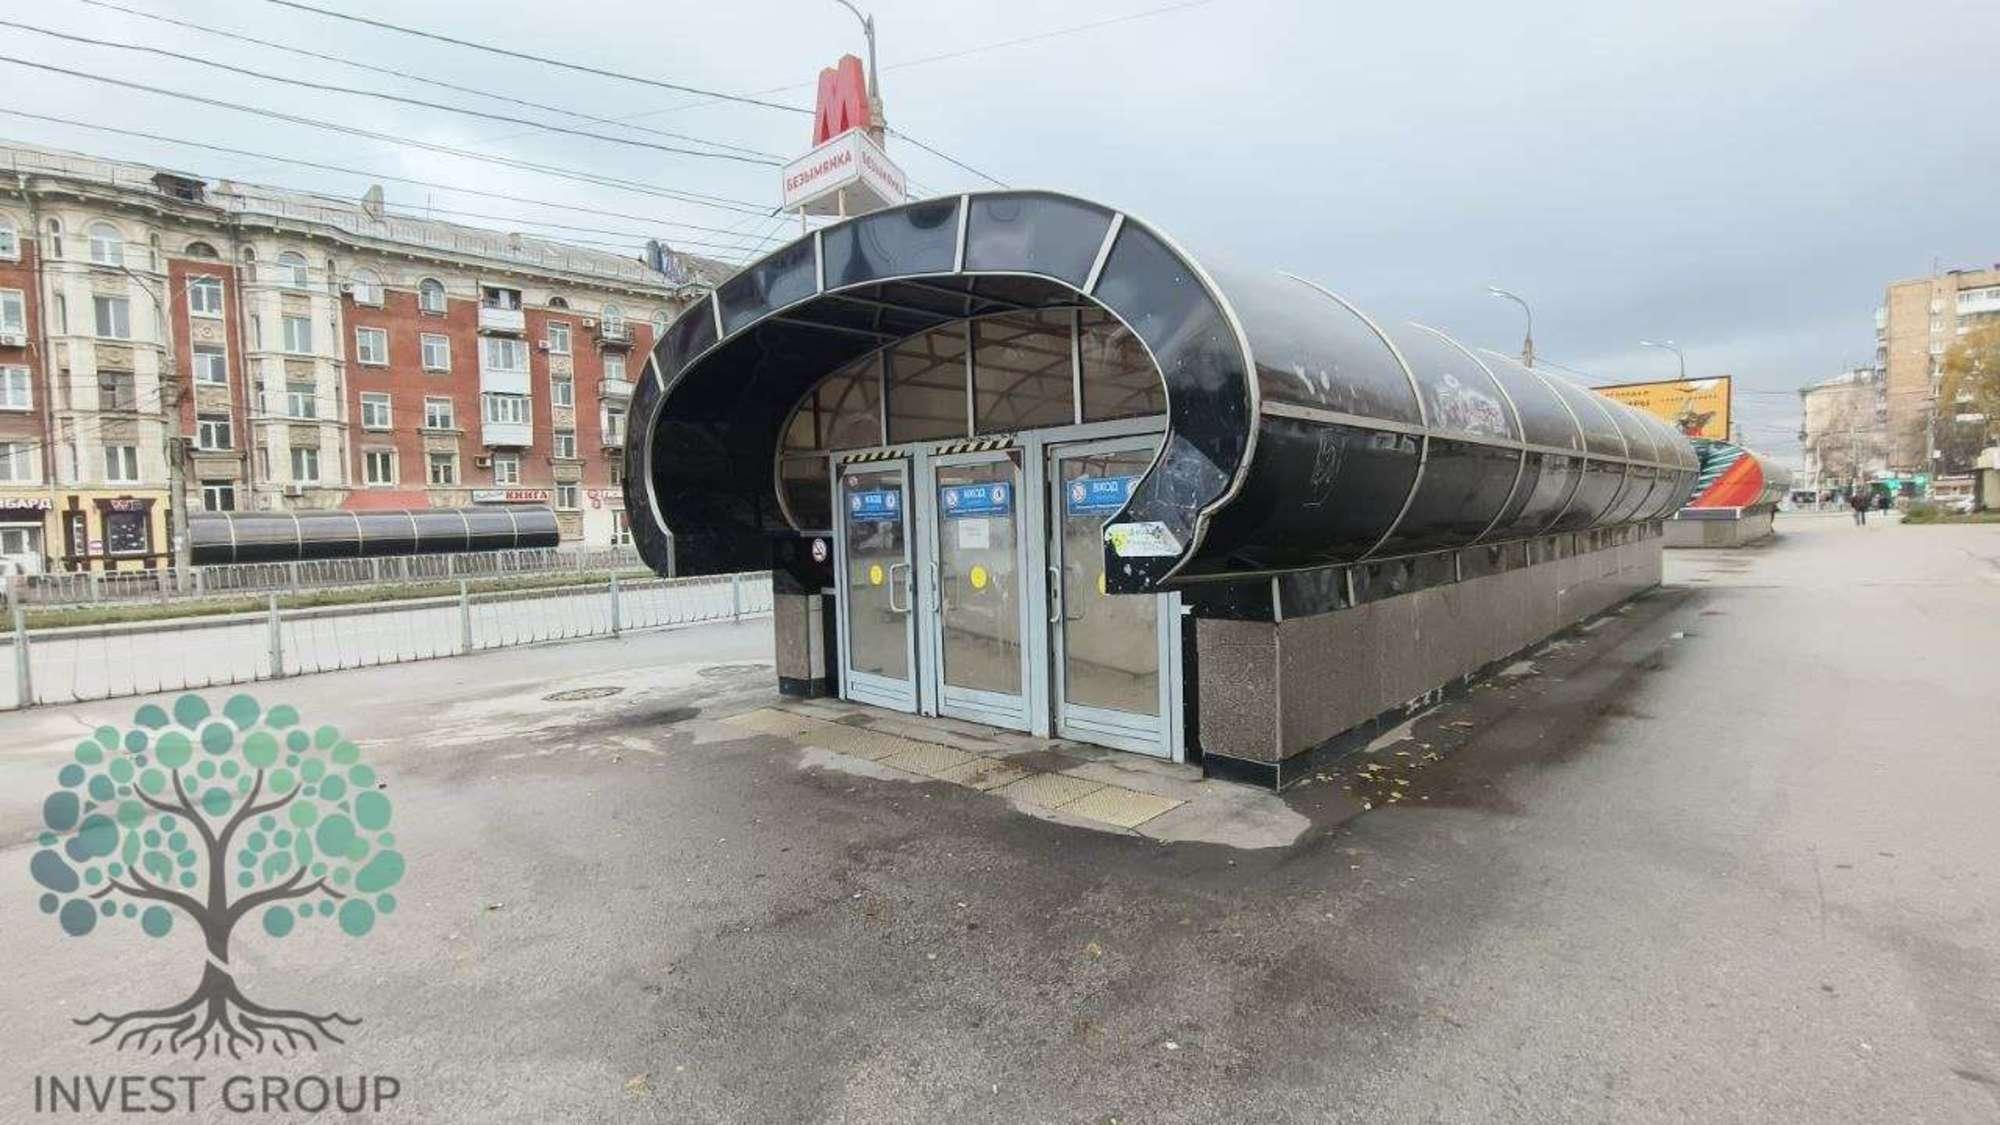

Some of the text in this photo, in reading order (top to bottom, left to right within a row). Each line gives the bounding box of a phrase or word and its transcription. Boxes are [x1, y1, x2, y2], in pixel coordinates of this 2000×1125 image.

[812, 53, 870, 148] М
[786, 150, 853, 192] БЕЗЫМЯНКА
[506, 489, 548, 500] КНИГА
